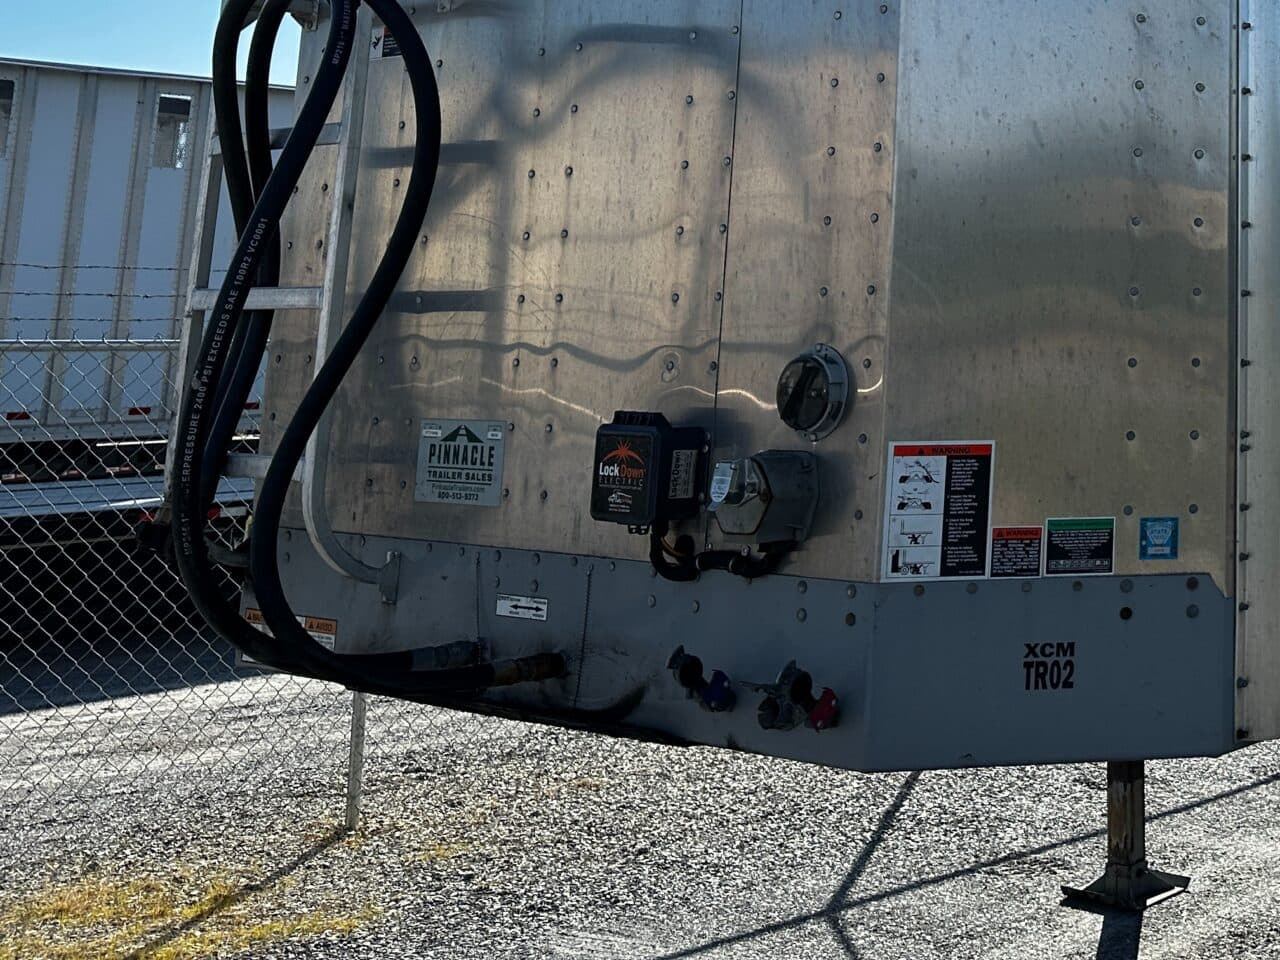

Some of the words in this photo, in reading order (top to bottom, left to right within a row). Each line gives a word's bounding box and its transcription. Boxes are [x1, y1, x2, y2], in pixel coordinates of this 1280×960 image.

[247, 217, 270, 253] VC0001
[233, 256, 252, 285] 100R2
[224, 289, 239, 311] SAE
[208, 313, 231, 362] EXCEEDS
[200, 364, 214, 383] PSI
[193, 385, 208, 410] 2400
[428, 443, 495, 467] PINNACLE
[931, 446, 970, 455] WARNING
[428, 470, 462, 480] TRAILER
[465, 472, 493, 482] SALES
[1023, 642, 1075, 659] XCM
[1023, 660, 1074, 691] TR02
